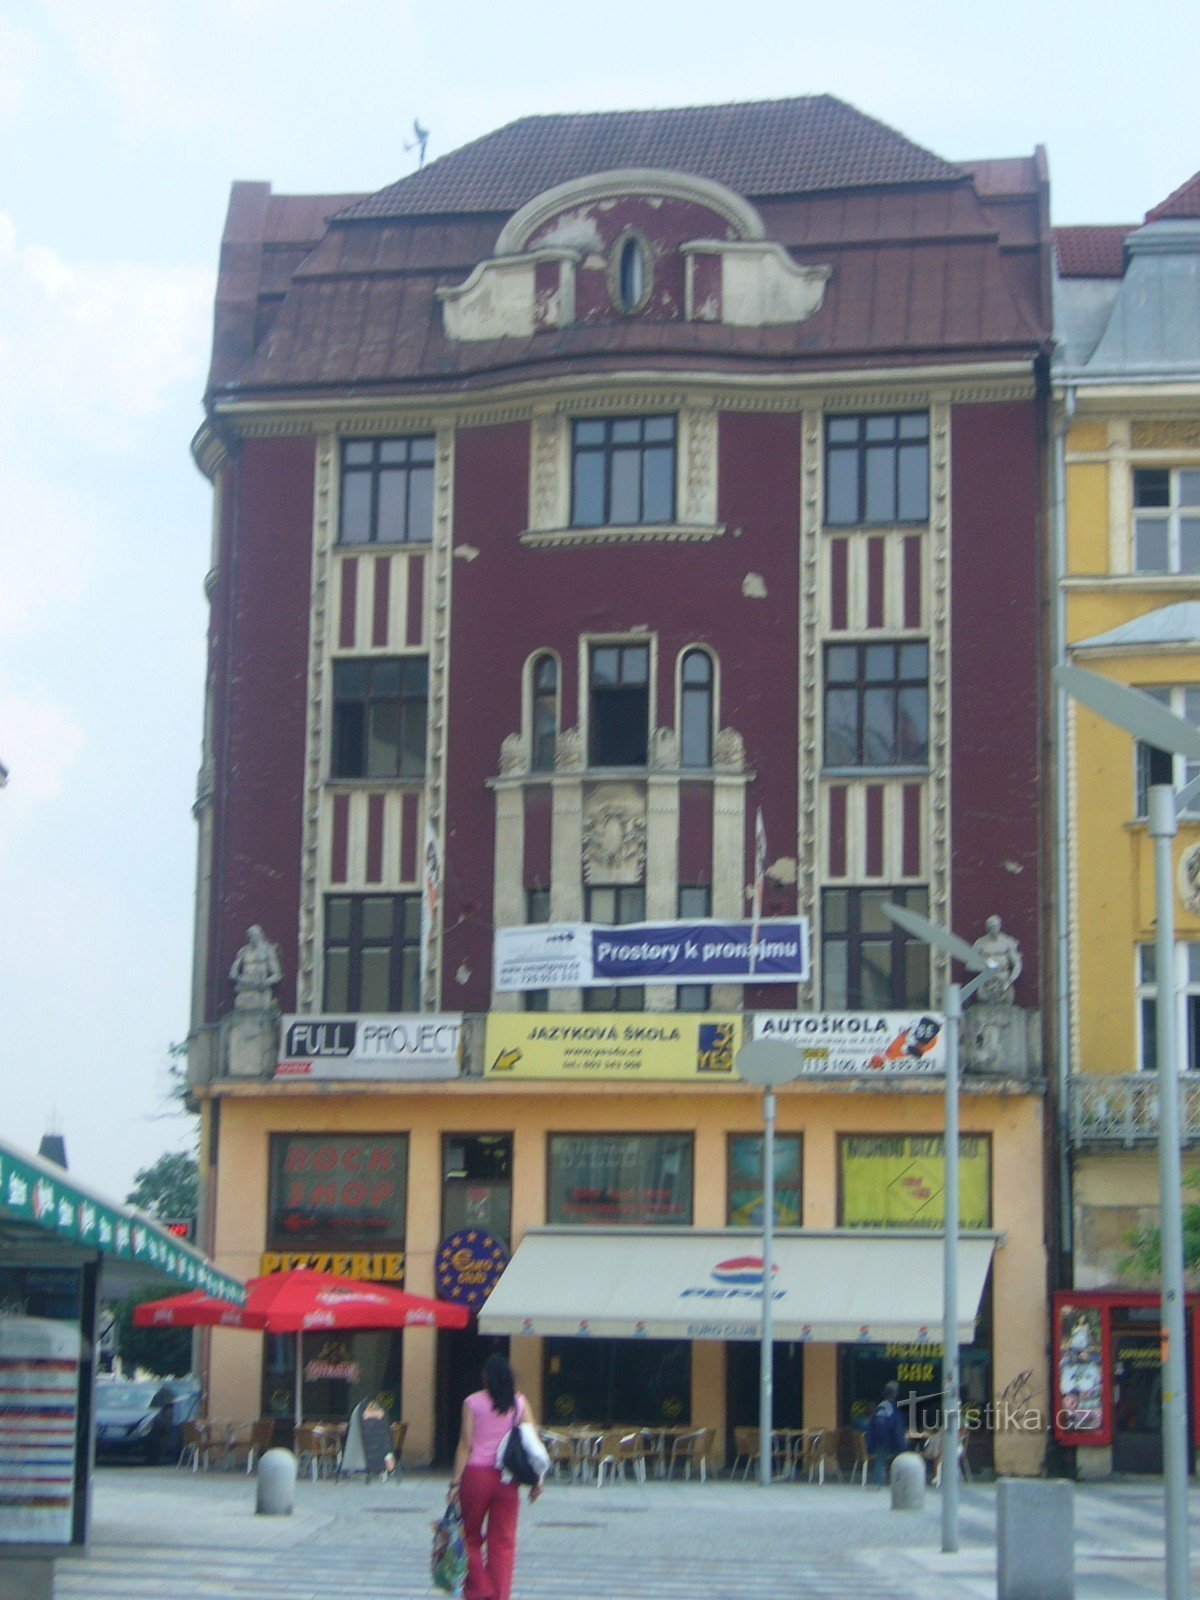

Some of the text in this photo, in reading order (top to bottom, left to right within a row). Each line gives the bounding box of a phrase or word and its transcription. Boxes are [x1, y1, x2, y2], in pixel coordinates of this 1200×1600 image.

[597, 941, 681, 963] Prostory
[685, 938, 699, 959] k
[527, 1023, 681, 1041] JAZYKOVÁ ŠKOLA
[761, 1013, 888, 1034] AUTOŠKOLA
[291, 1023, 460, 1056] FULL PROJECT
[284, 1144, 395, 1174] ROCK
[285, 1179, 394, 1209] SHOP
[260, 1251, 404, 1282] PIZZERIE
[687, 1324, 758, 1336] EURO CLUB
[896, 1363, 935, 1382] BAR
